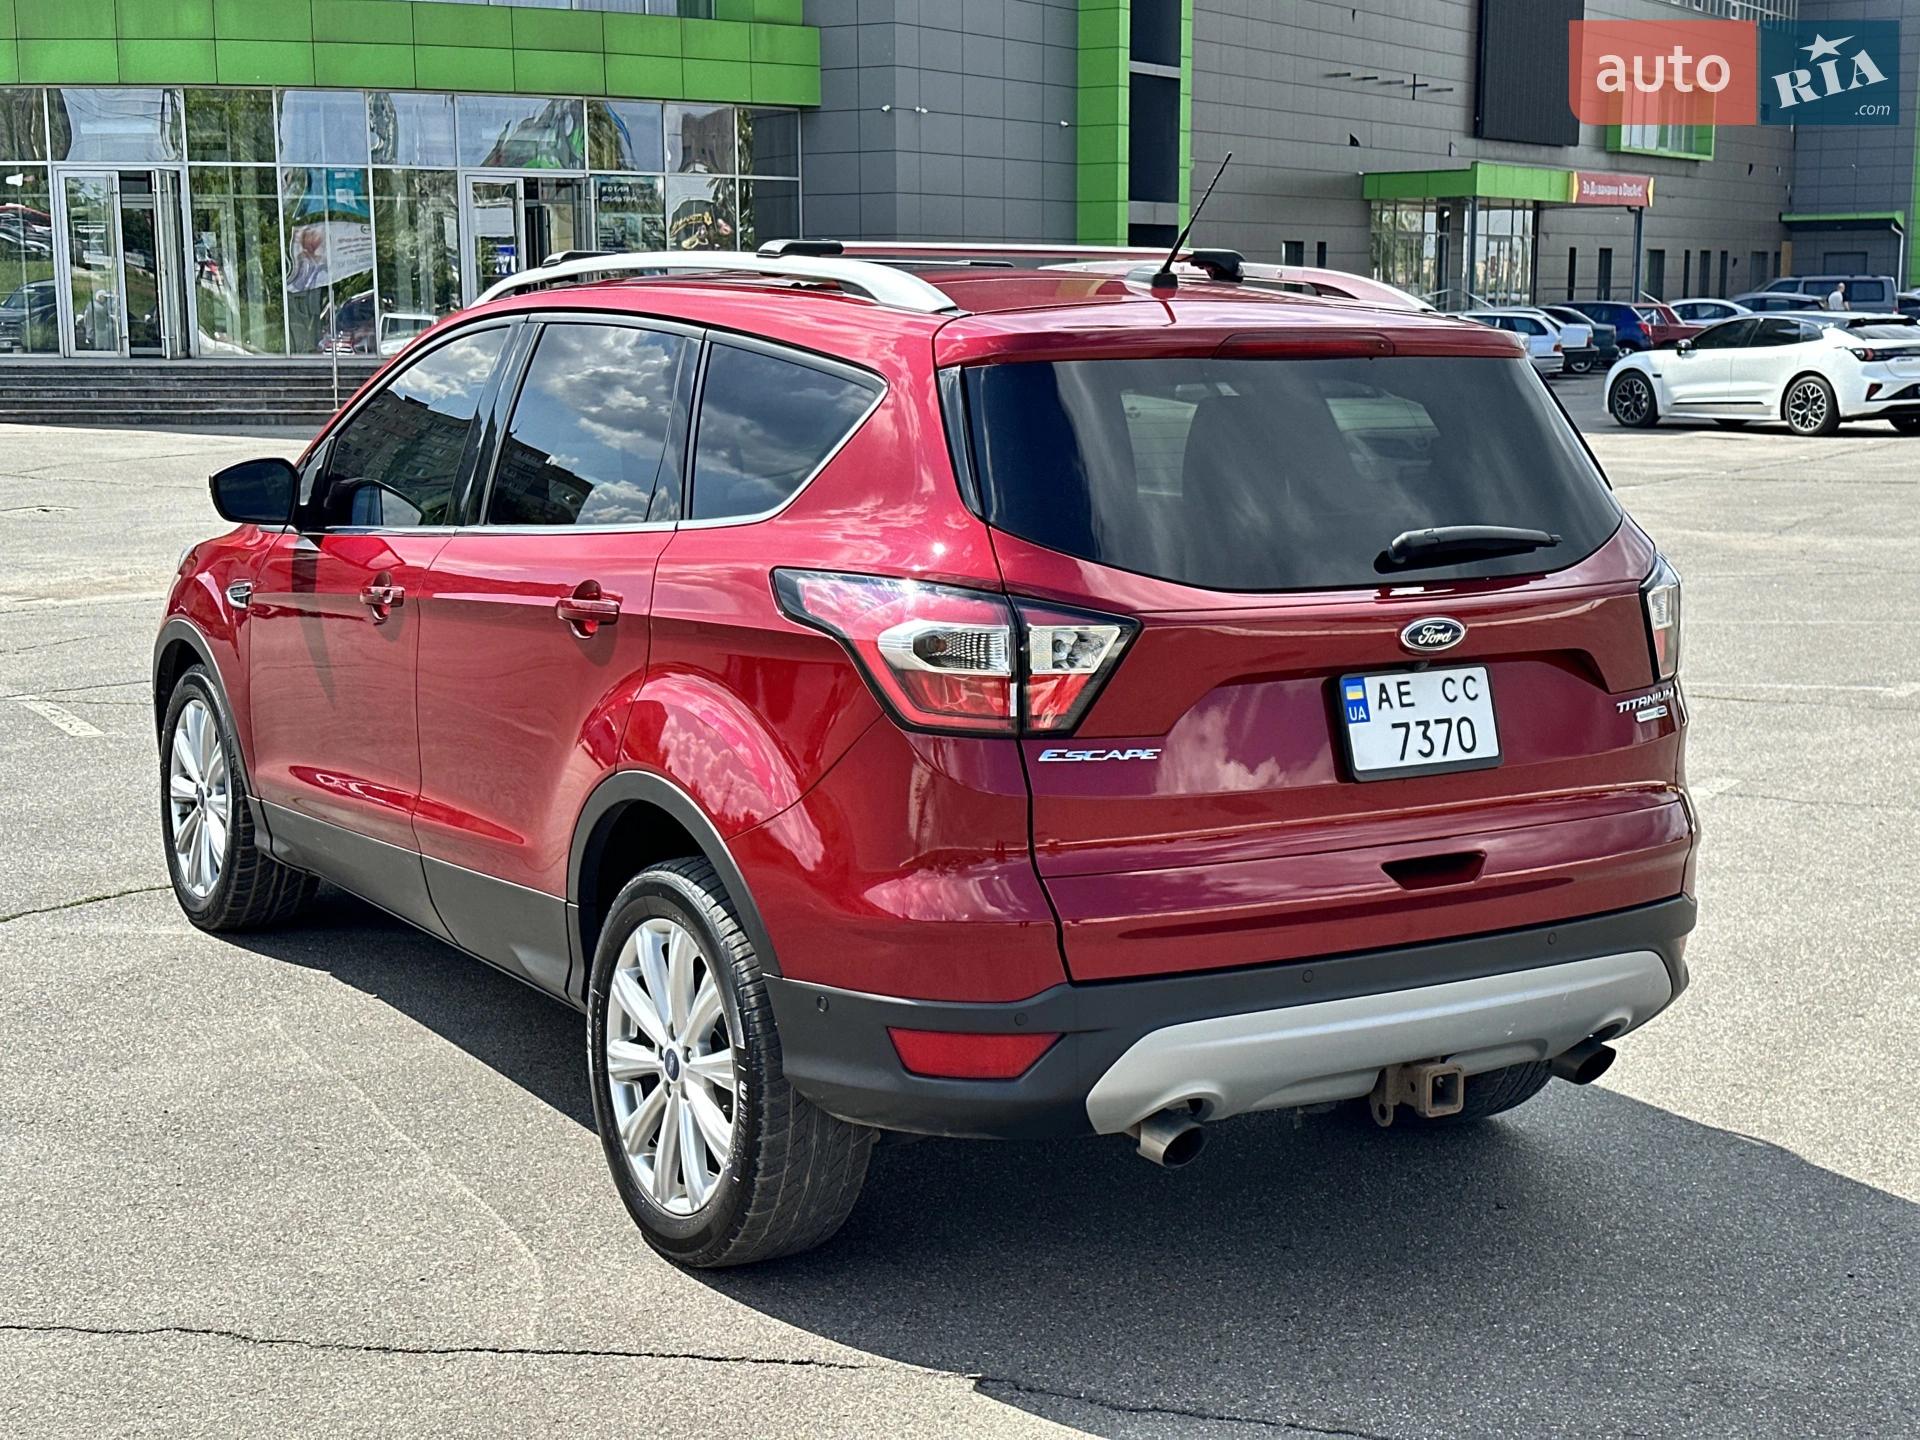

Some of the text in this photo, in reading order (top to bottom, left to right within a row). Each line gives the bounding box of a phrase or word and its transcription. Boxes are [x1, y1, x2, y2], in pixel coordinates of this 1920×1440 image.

[1417, 624, 1453, 645] Ford
[1378, 675, 1479, 711] AE CC
[1615, 687, 1674, 714] TITANIUM
[1348, 705, 1367, 722] UA
[1391, 716, 1477, 761] 7370
[1038, 749, 1162, 762] ESCAPE
